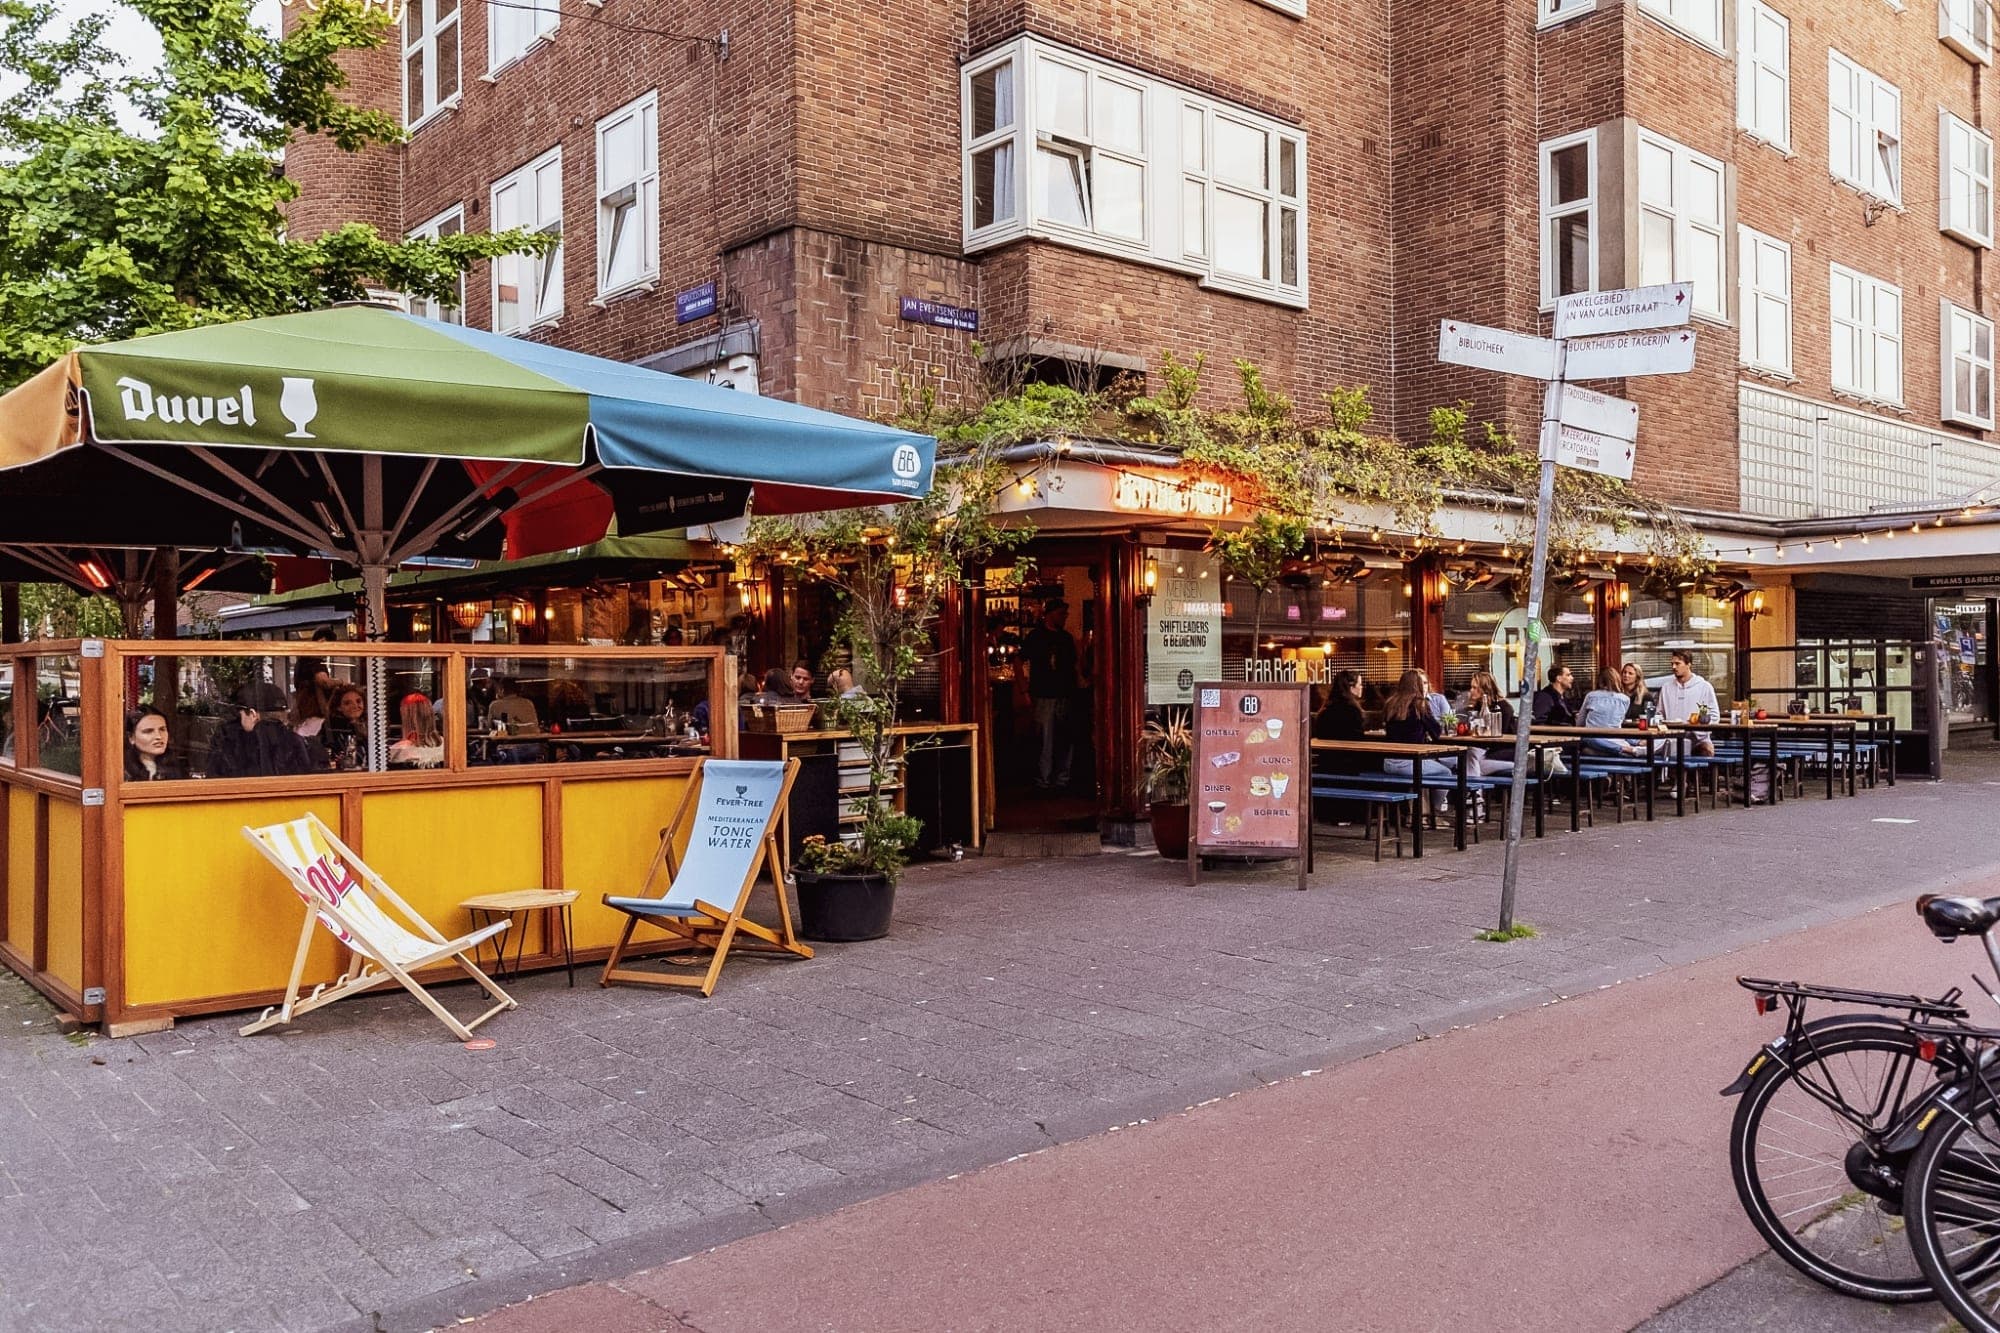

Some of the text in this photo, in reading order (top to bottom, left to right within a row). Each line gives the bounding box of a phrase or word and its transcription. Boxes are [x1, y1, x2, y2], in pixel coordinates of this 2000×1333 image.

[903, 298, 917, 311] JAN
[1565, 301, 1658, 320] AN VAN GALENSTRAAT
[1458, 337, 1505, 355] BIBLIOTHEEK
[1569, 335, 1671, 352] BUURTHUIS DE TAGERIJN
[115, 376, 258, 427] Duvel
[1561, 427, 1601, 446] RKEERGARAGE
[1560, 440, 1599, 457] RCATORPLEIN
[1929, 577, 1963, 585] KWAMS
[1159, 620, 1210, 634] SHIFTLEADERS
[1163, 635, 1207, 648] & BEDIENING
[1244, 696, 1258, 714] BB
[1204, 784, 1232, 792] DINER
[716, 797, 764, 807] FEVER-TREE
[1253, 808, 1290, 816] BORREL
[707, 815, 764, 824] MEDITERRANEAN
[712, 825, 753, 838] TONIC
[708, 836, 752, 849] WATER
